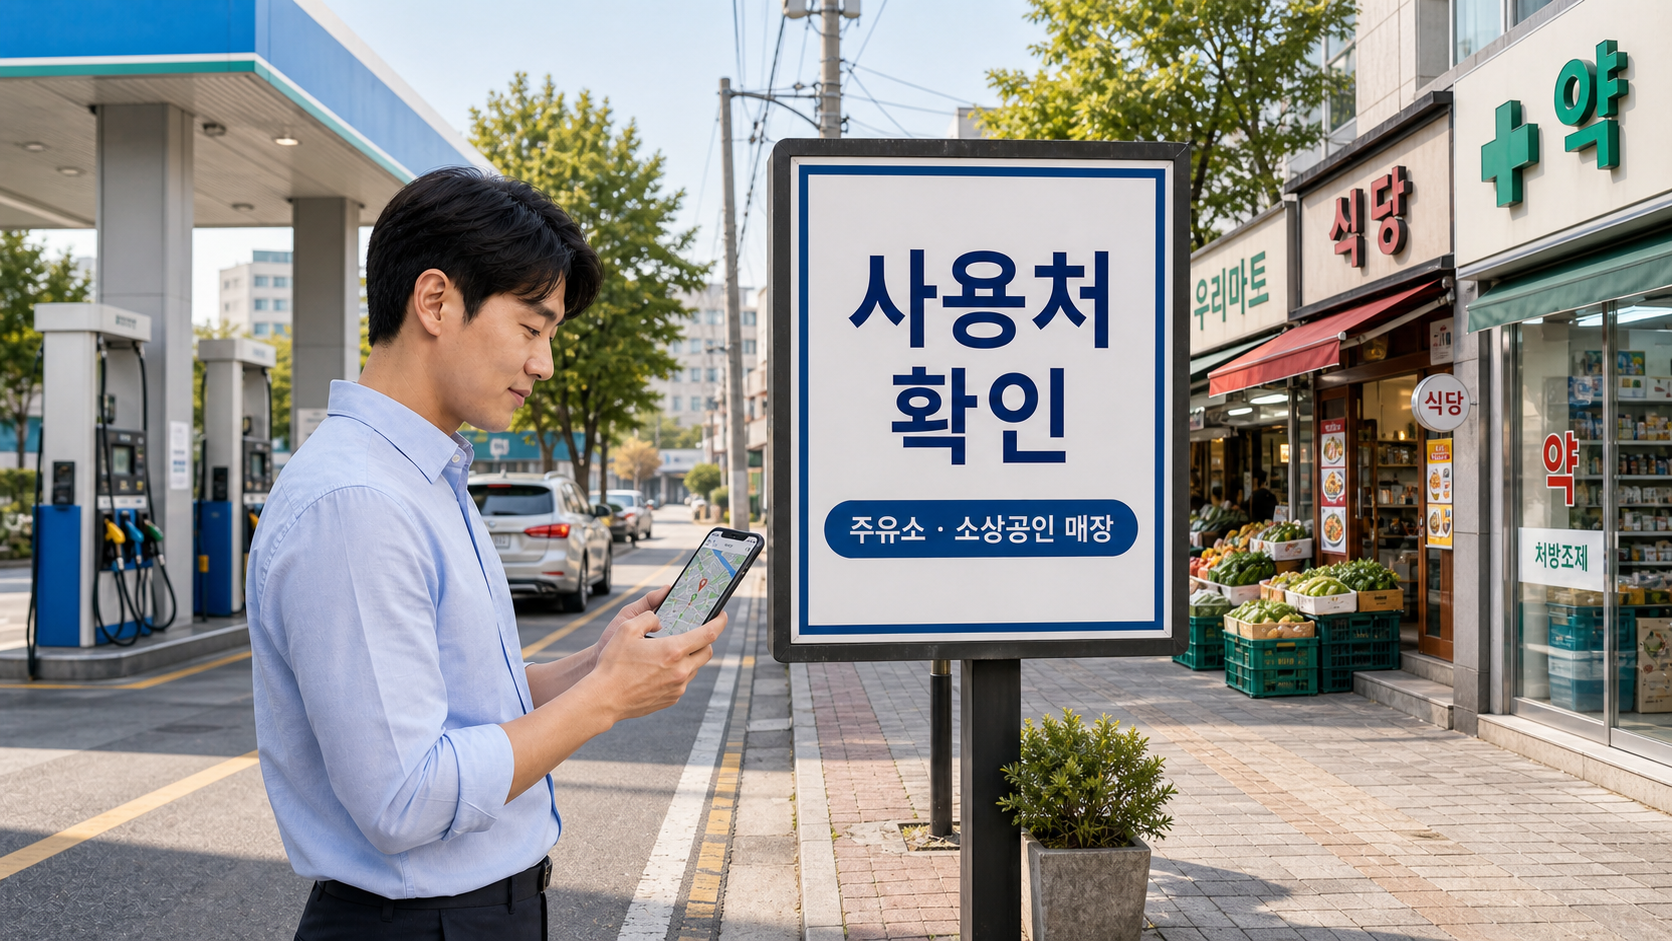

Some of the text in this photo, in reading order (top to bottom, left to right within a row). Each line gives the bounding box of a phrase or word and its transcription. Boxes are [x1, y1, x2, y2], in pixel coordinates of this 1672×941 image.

[1554, 39, 1629, 170] 약
[1329, 166, 1413, 268] 식당
[848, 249, 1109, 349] 사용처
[891, 366, 1067, 465] 확인
[1425, 391, 1464, 416] 식당
[1542, 430, 1580, 507] 약
[849, 515, 926, 544] 주유소
[954, 514, 1054, 544] 소상공인
[1065, 514, 1114, 543] 매장
[1535, 541, 1588, 572] 처방조제
